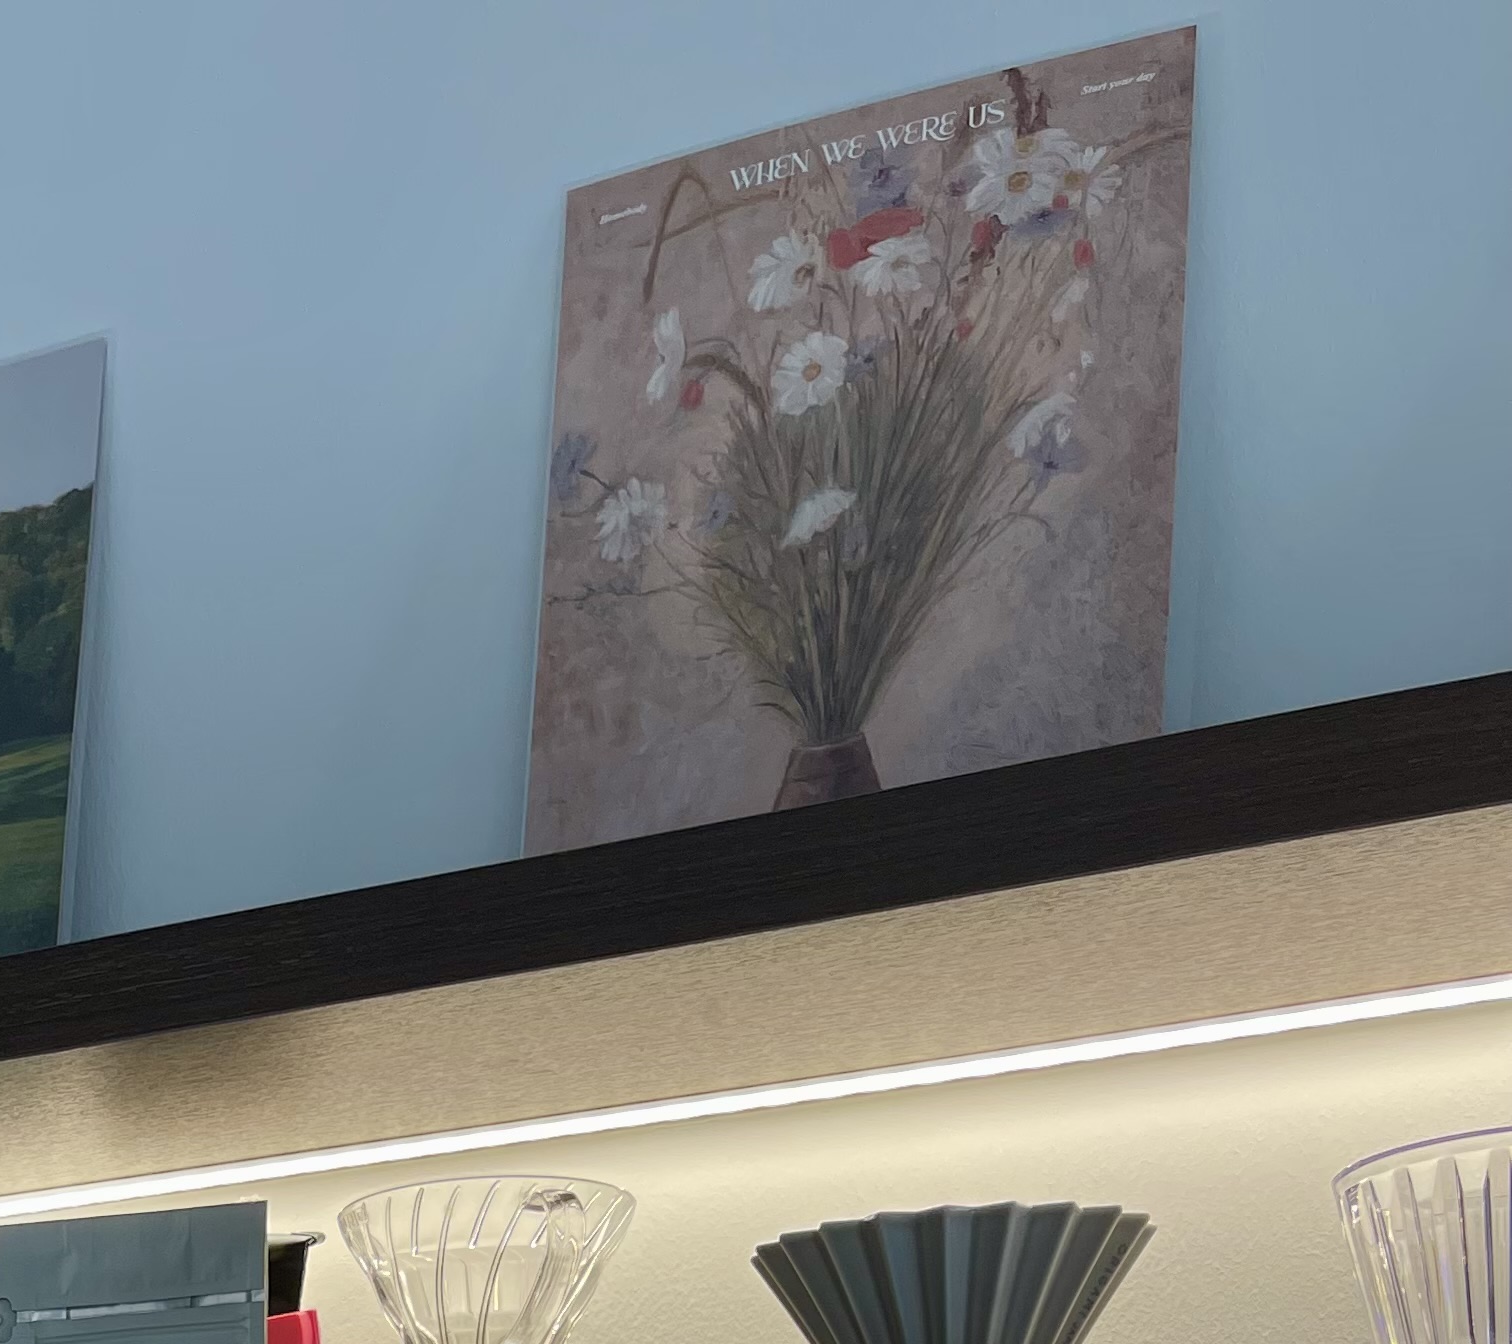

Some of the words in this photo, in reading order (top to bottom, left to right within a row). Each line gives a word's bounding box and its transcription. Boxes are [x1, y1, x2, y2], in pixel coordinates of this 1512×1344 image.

[1081, 82, 1107, 96] Start
[1108, 77, 1135, 91] your
[1135, 72, 1157, 84] day
[728, 147, 810, 193] WHEN
[821, 132, 868, 166] WE
[876, 108, 960, 152] WERE
[967, 98, 1007, 131] US
